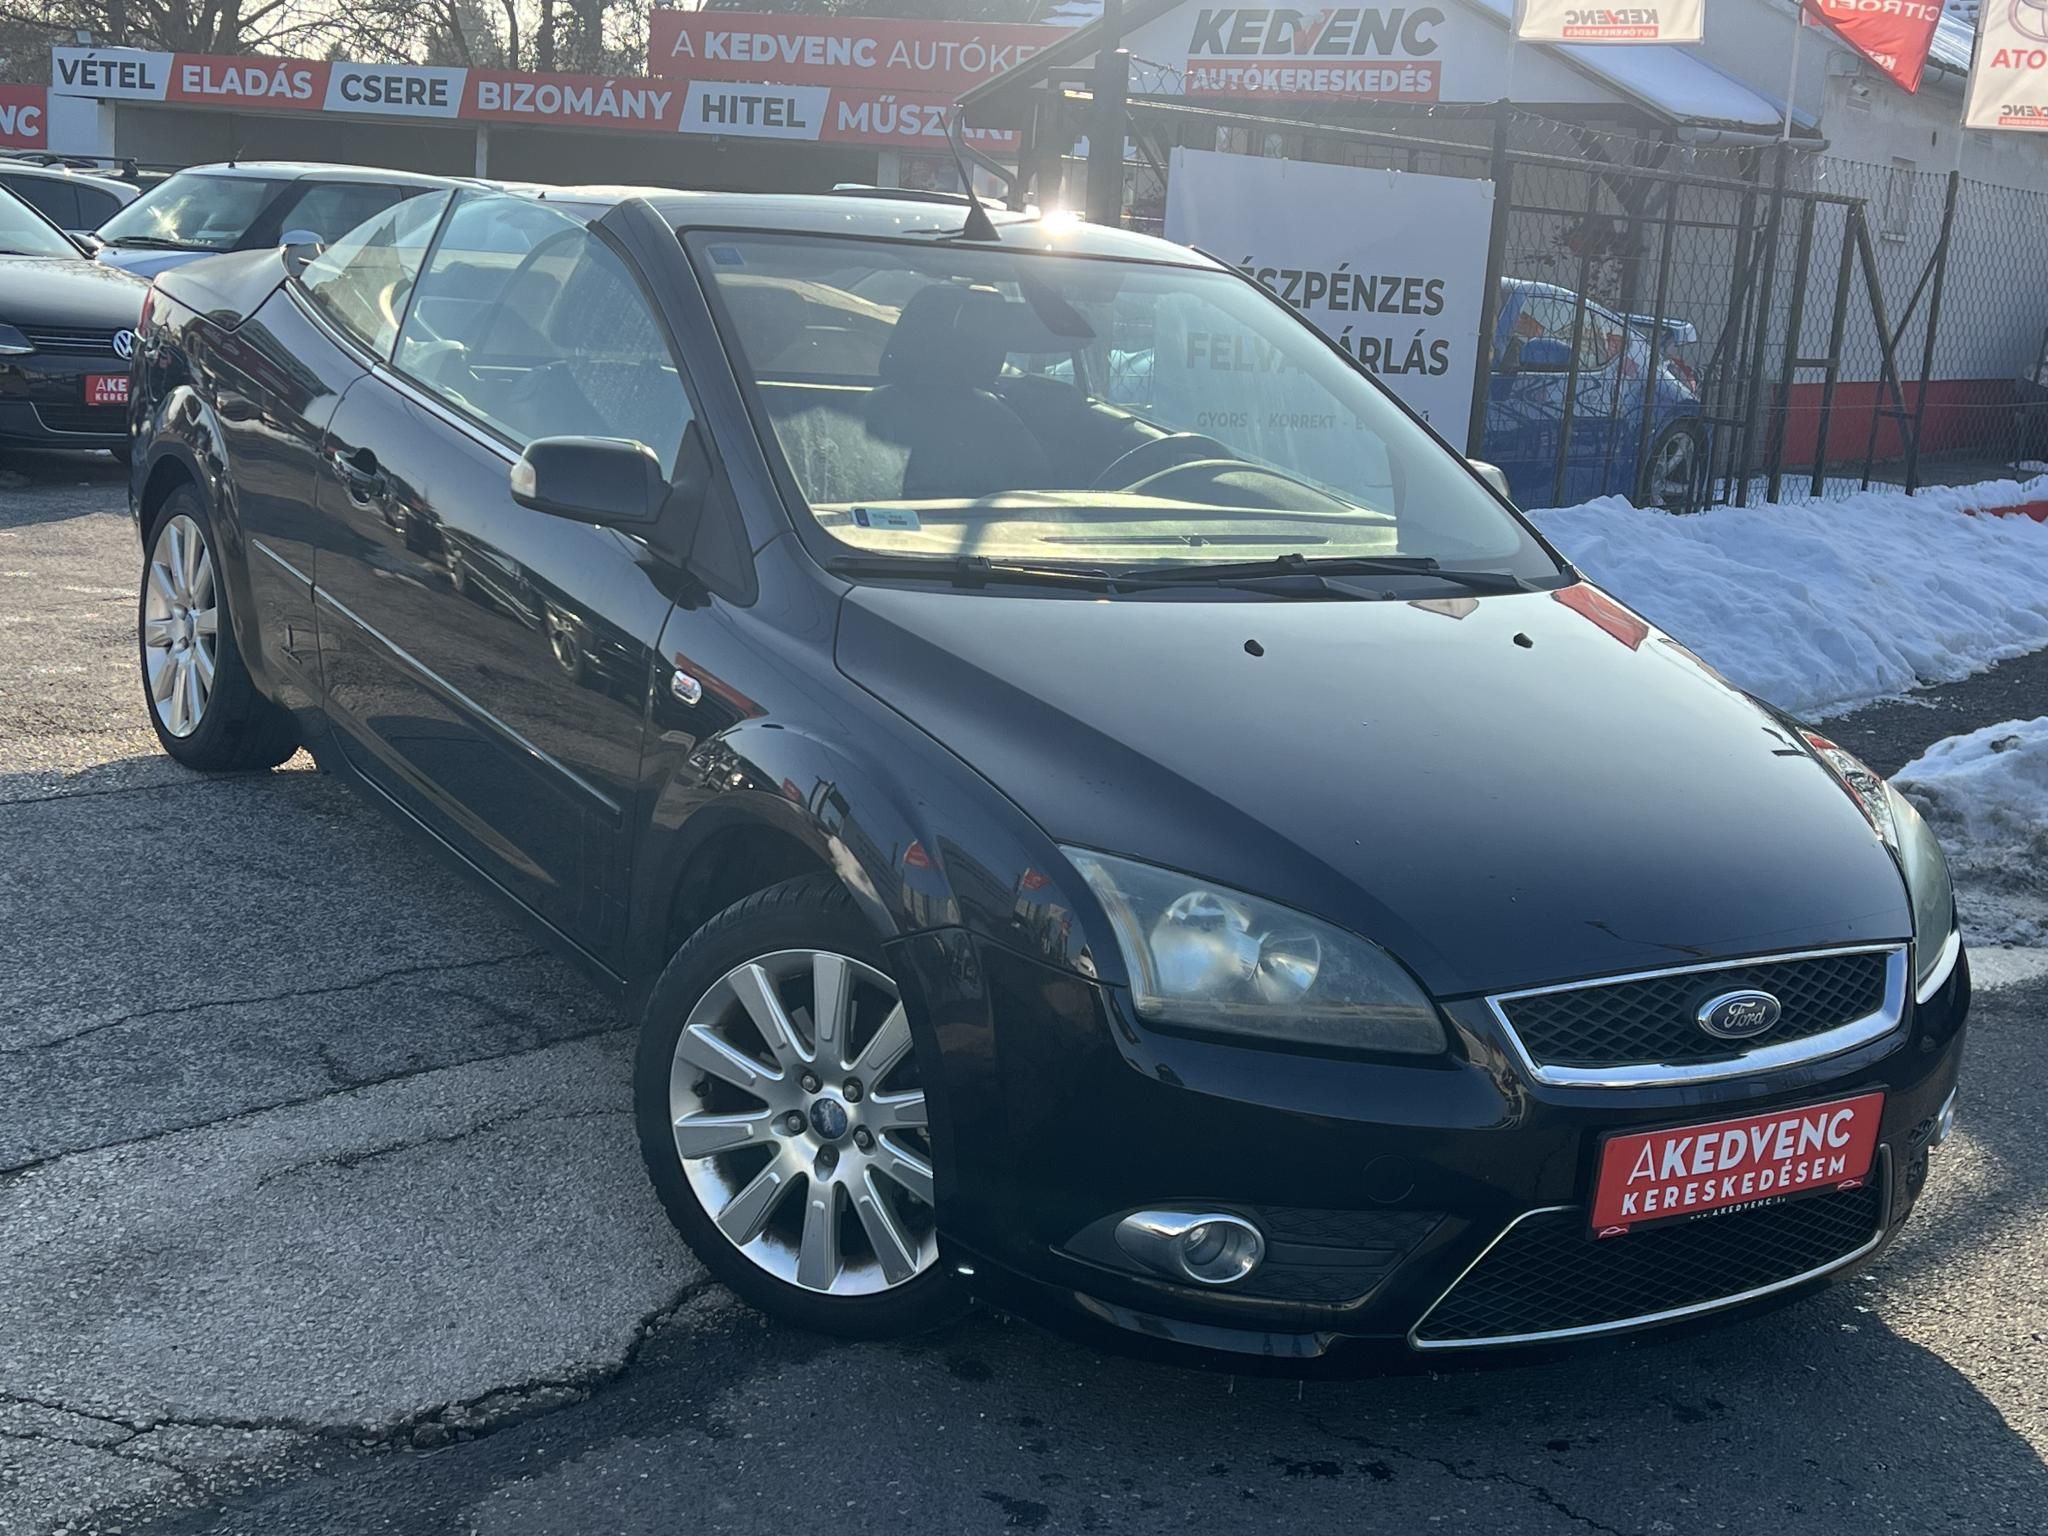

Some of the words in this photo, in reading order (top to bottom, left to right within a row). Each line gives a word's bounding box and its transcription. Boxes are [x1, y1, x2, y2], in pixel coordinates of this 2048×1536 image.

[671, 30, 695, 58] A
[704, 31, 878, 68] KEDVENC
[1187, 7, 1446, 57] KEDVENC
[57, 53, 156, 90] VÉTEL
[182, 62, 313, 99] ELADÁS
[340, 74, 448, 107] CSERE
[478, 80, 672, 120] BIZOMÁNY
[702, 94, 807, 128] HITEL
[1192, 64, 1433, 93] AUTÓKERESKEDÉS
[1196, 412, 1249, 428] GYORS
[1268, 412, 1337, 430] KORREKT
[1723, 1001, 1767, 1029] Ford
[1621, 1154, 1847, 1216] KERESKEDÉSEM
